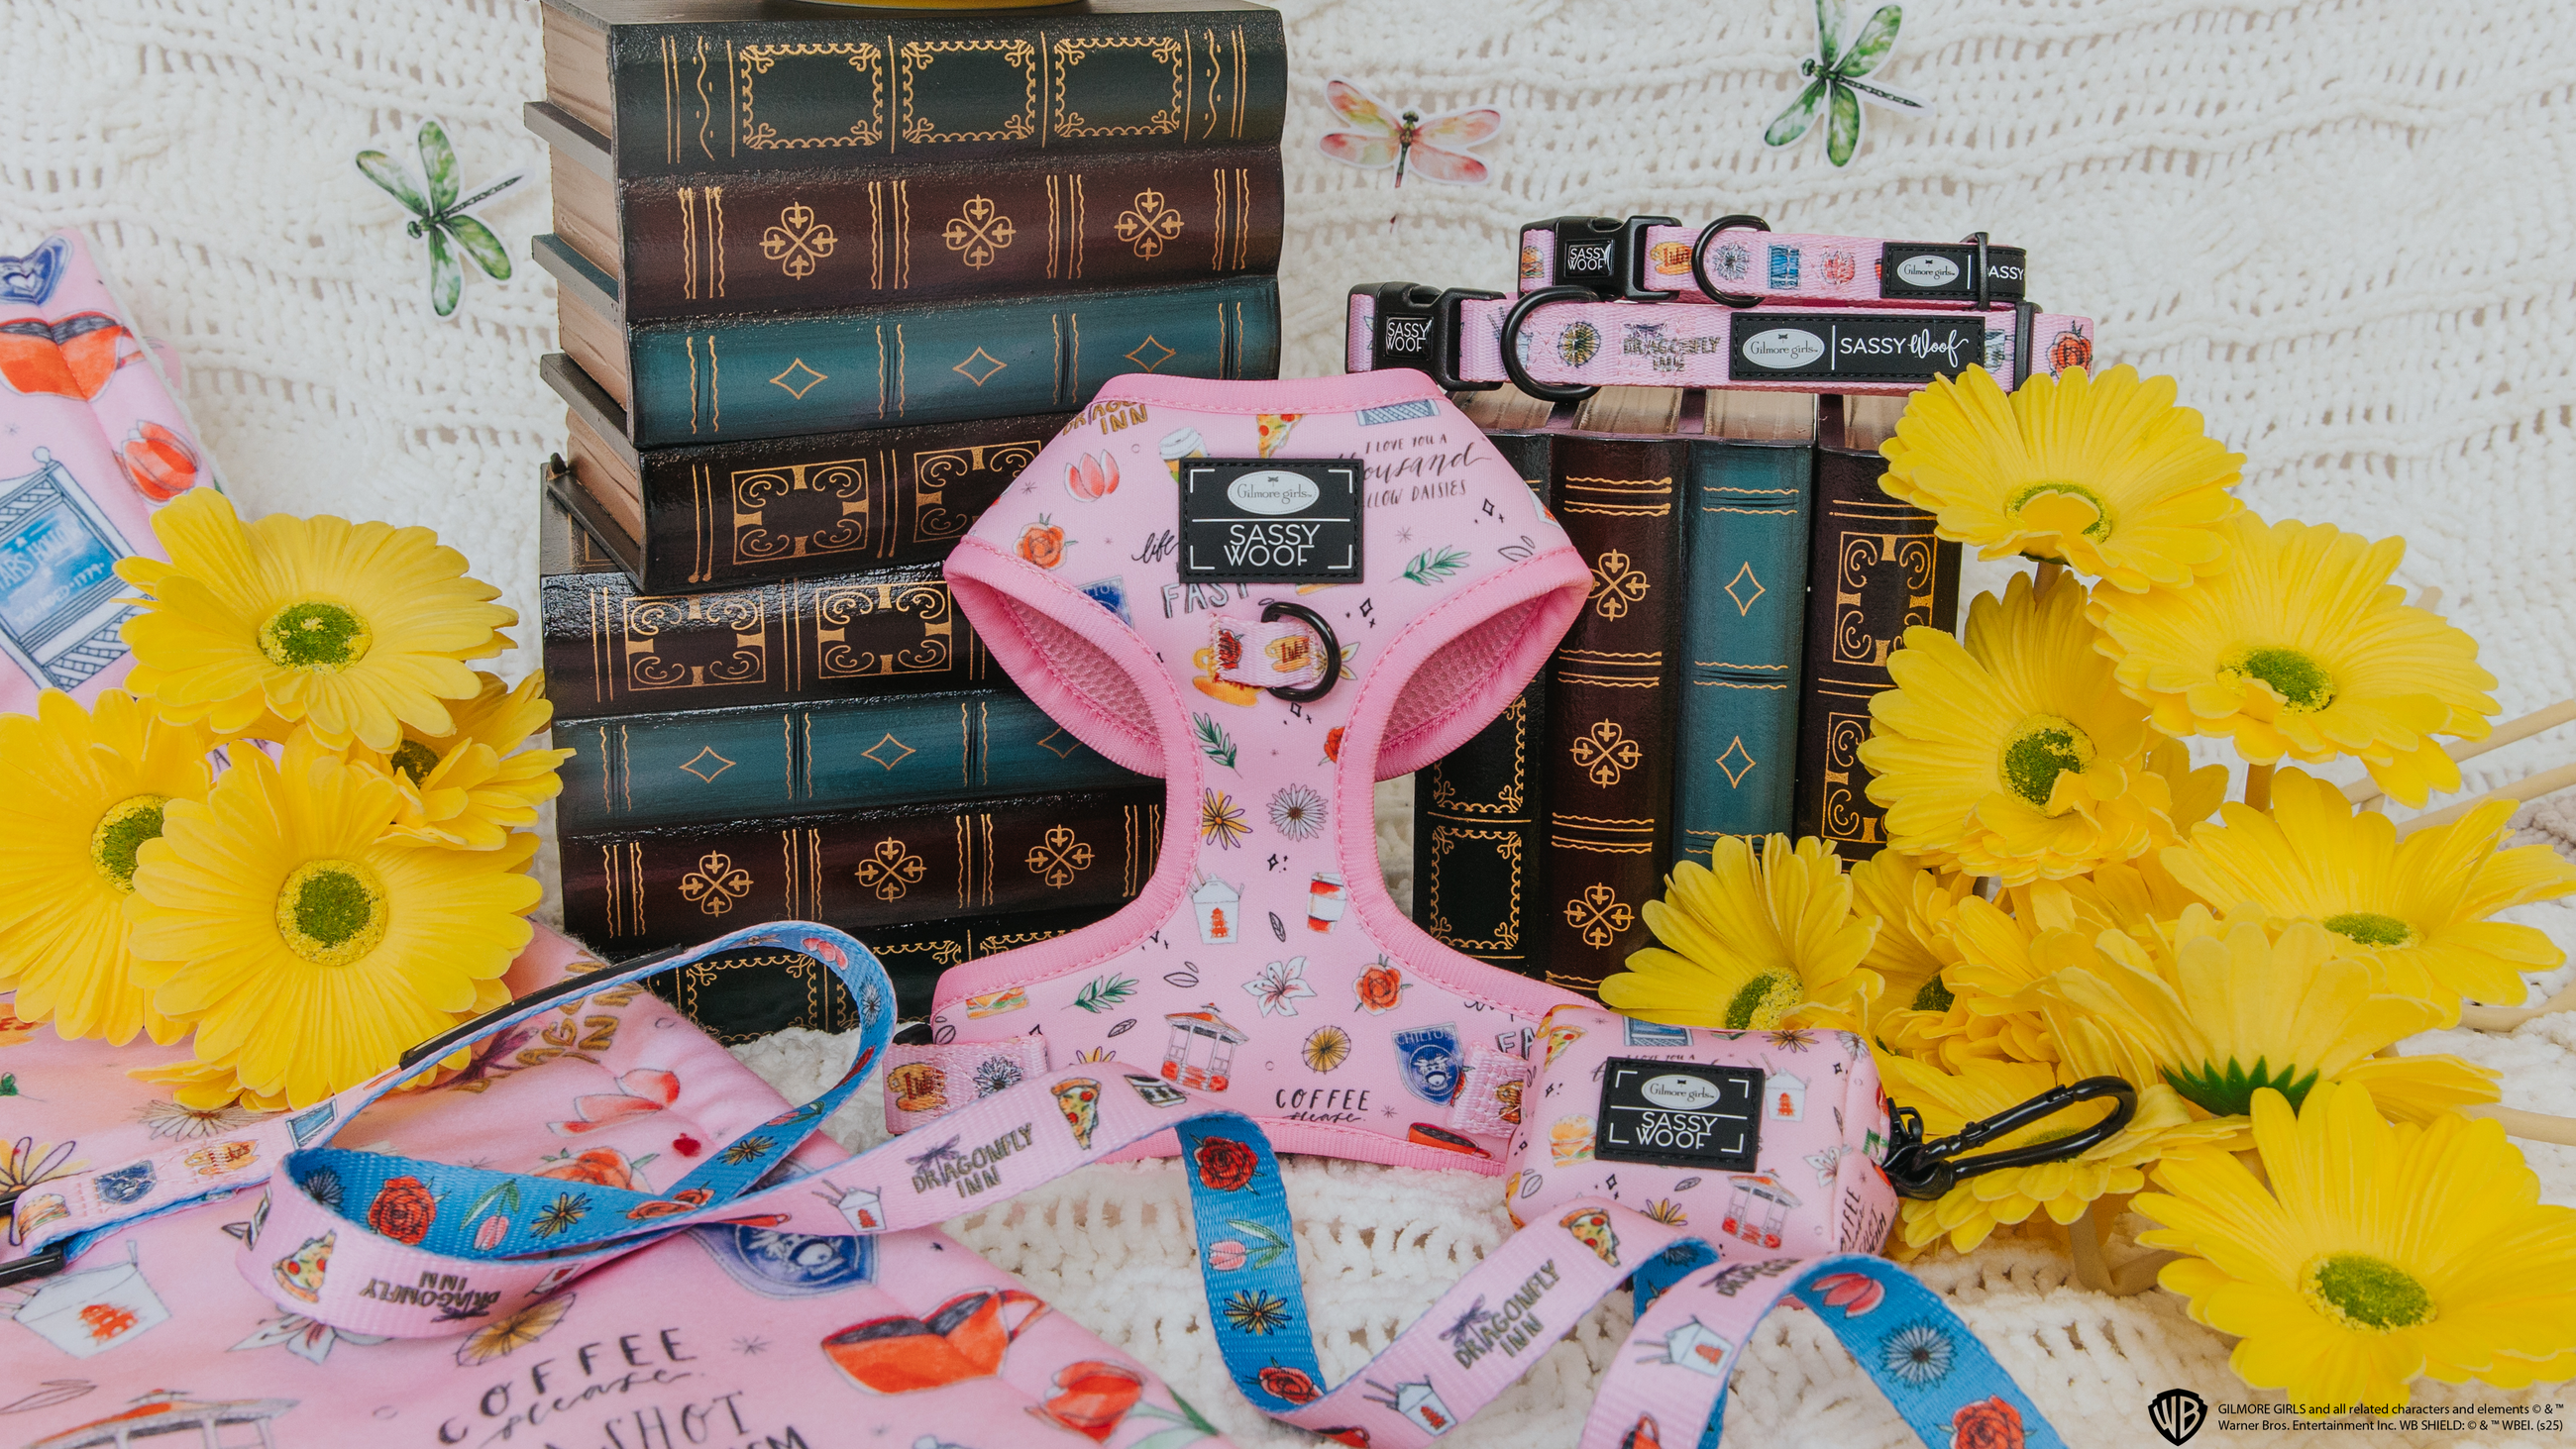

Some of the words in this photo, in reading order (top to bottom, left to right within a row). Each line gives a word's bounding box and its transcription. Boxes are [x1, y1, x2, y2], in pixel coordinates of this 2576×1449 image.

[1569, 248, 1608, 259] SASSY
[1567, 259, 1607, 271] WOOF
[1903, 263, 1933, 276] Gilmore
[1986, 264, 2024, 281] ASSY
[1387, 322, 1430, 338] SASSY
[1386, 337, 1427, 353] WOOF
[1750, 341, 1790, 356] Gilmore
[1839, 338, 1907, 355] SASSY
[1907, 328, 1970, 368] Woof
[1100, 403, 1148, 435] INN
[1375, 438, 1405, 453] LOVE
[1412, 435, 1436, 448] YOU
[1440, 433, 1449, 444] A
[1236, 483, 1280, 498] Gilmore
[1411, 479, 1466, 502] DAISIES
[1230, 523, 1321, 545] SASSY
[1224, 545, 1315, 567] WOOF
[1275, 1088, 1371, 1111] COFFEE
[1650, 1083, 1687, 1097] Gilmore
[1641, 1111, 1718, 1133] SASSY
[1636, 1127, 1712, 1150] WOOF
[912, 1122, 1032, 1194] DRAGONFLY
[956, 1165, 1002, 1198] INN
[359, 1278, 501, 1307] DRAGONFLY
[419, 1271, 469, 1292] INN
[1453, 1258, 1560, 1370] DRAGONFLY
[1499, 1312, 1545, 1358] INN
[437, 1328, 698, 1445] COFFEE
